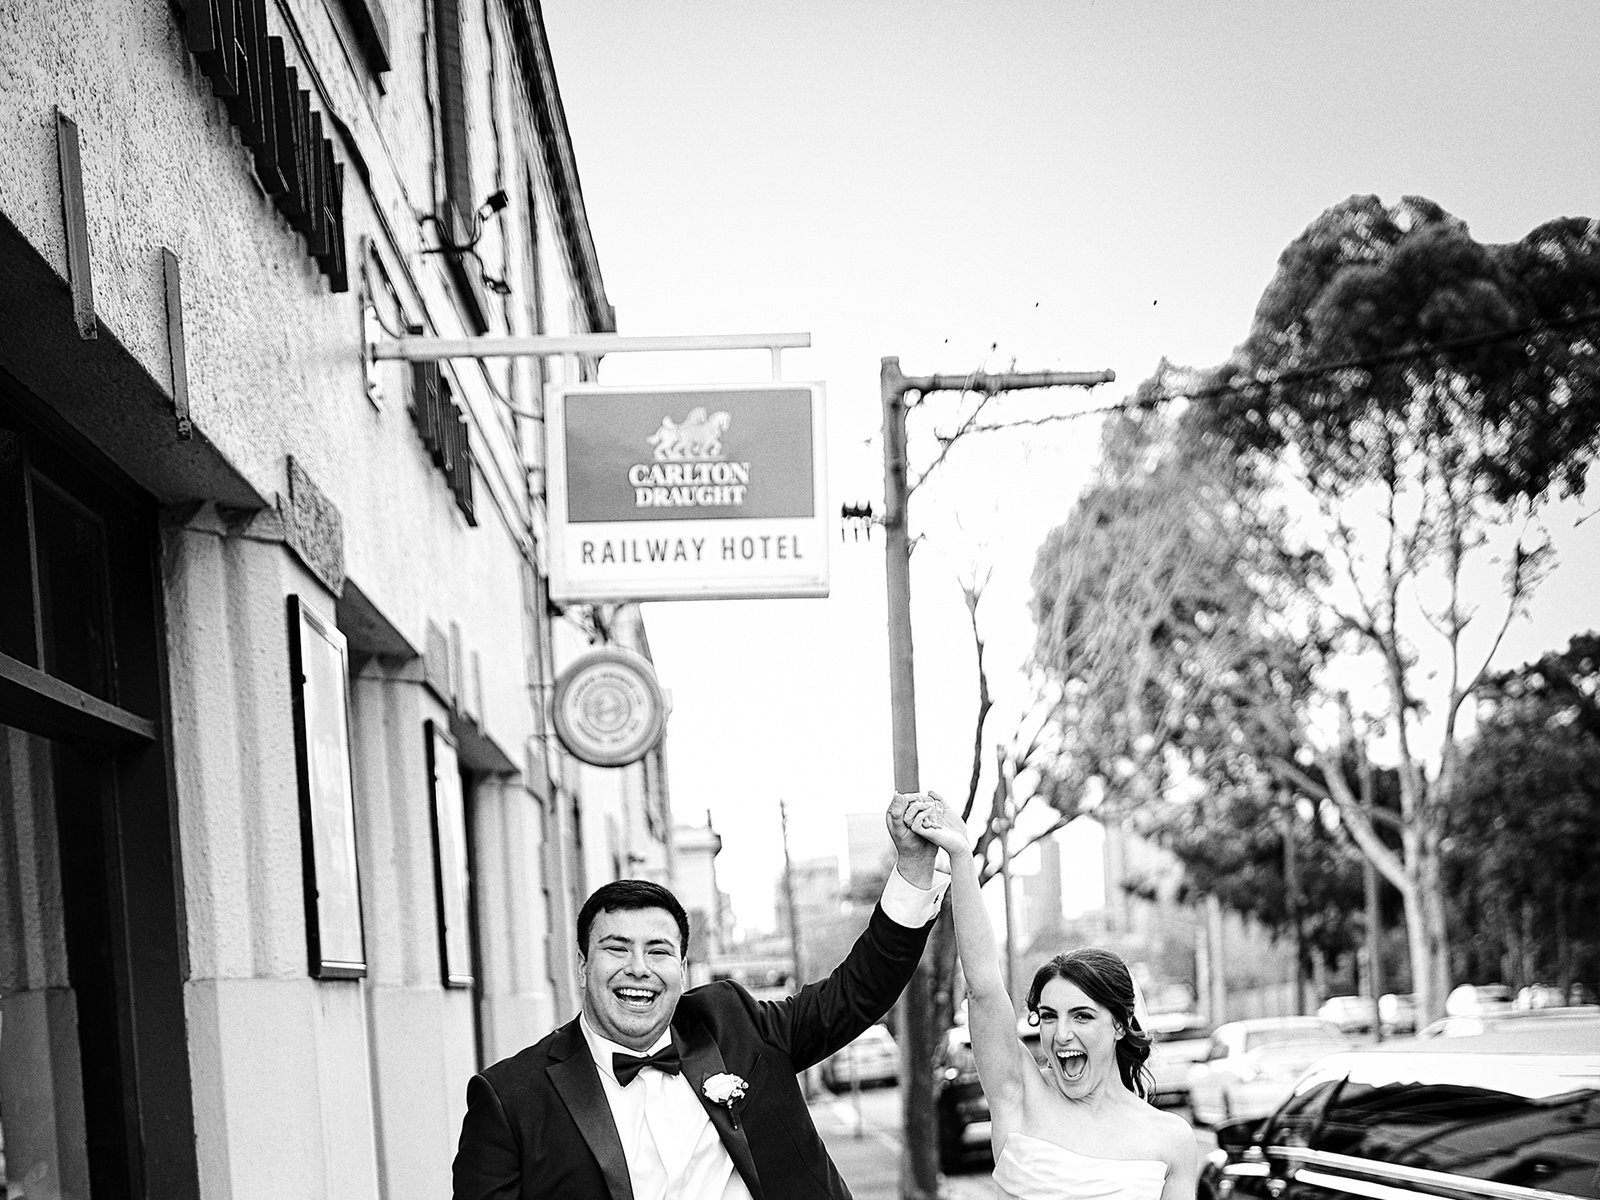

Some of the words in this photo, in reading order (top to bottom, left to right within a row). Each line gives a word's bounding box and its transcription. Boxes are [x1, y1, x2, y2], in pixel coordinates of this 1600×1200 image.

[628, 461, 750, 487] CARLTON
[634, 485, 747, 508] DRAUGHT
[581, 537, 705, 564] RAILWAY
[721, 535, 803, 561] HOTEL
